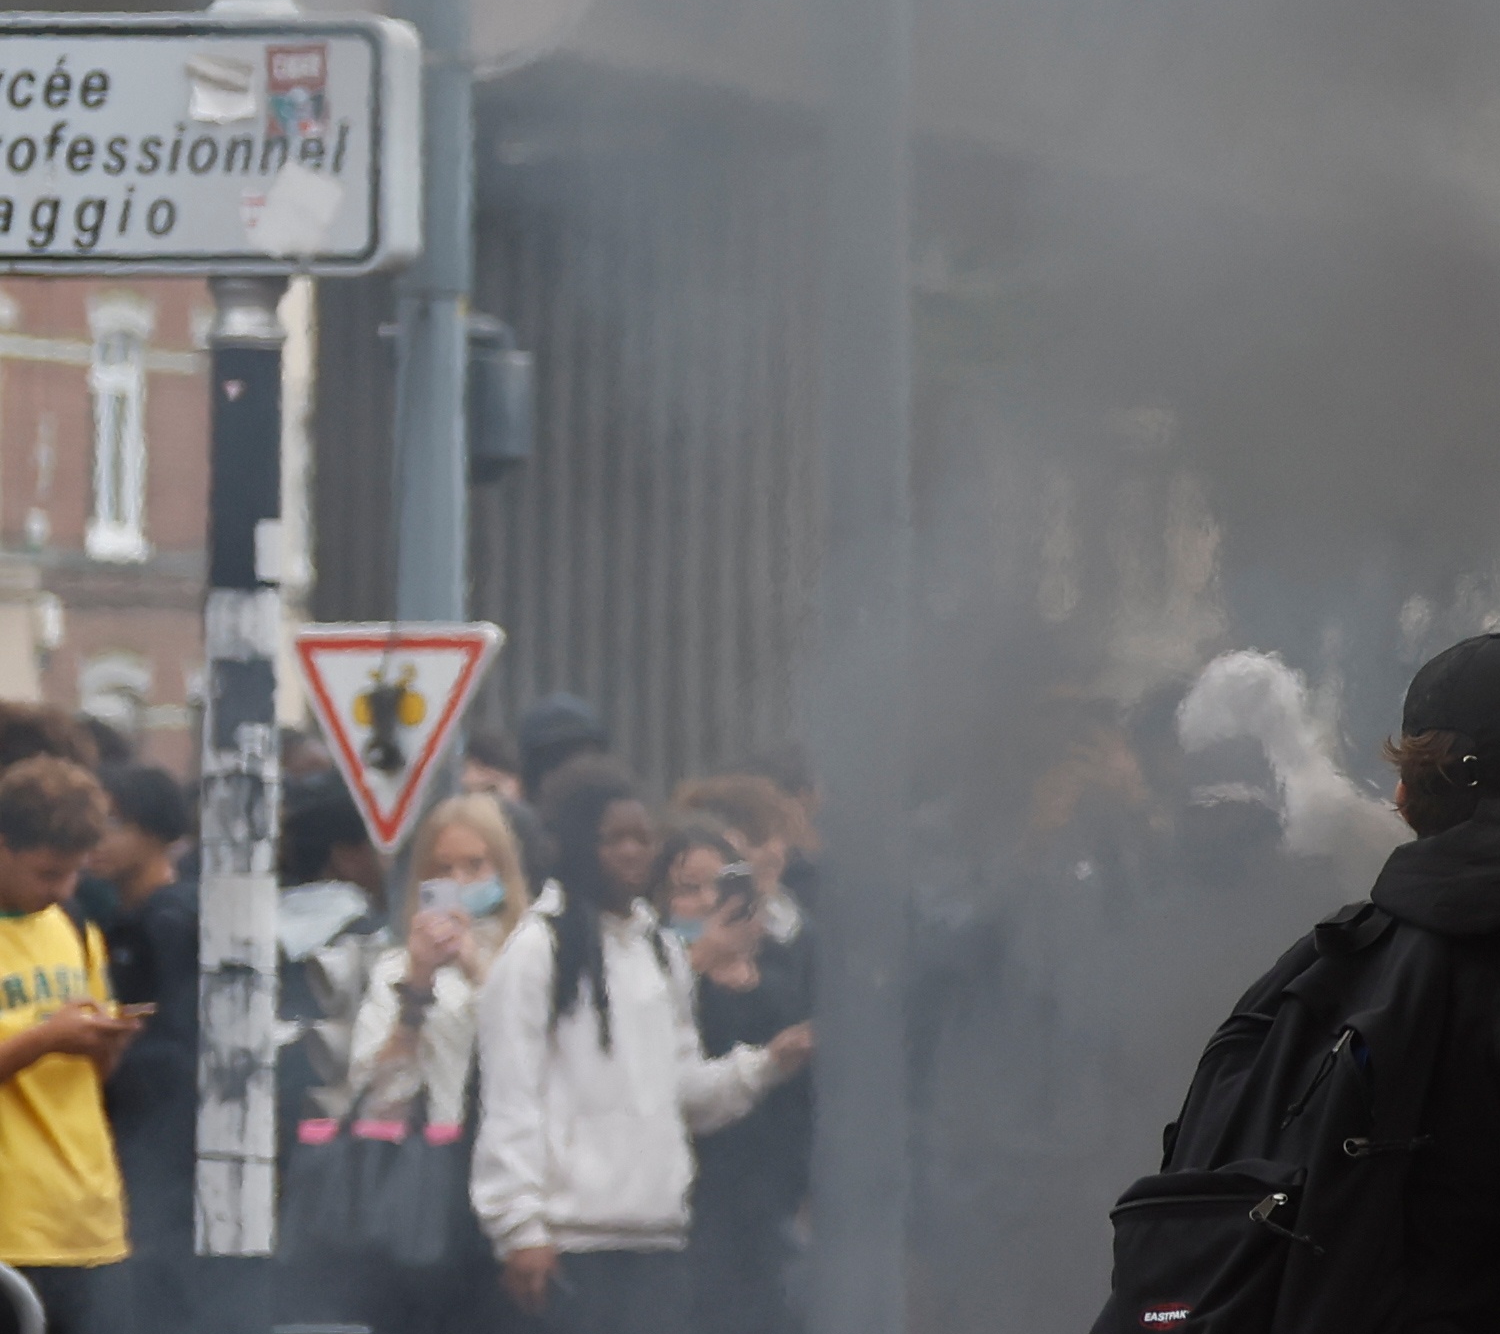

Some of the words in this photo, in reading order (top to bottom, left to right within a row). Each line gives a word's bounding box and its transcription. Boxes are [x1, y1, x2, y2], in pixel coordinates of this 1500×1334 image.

[0, 54, 110, 109] cée
[0, 121, 348, 174] ofessionnel
[1144, 1309, 1188, 1323] EASTPAK
